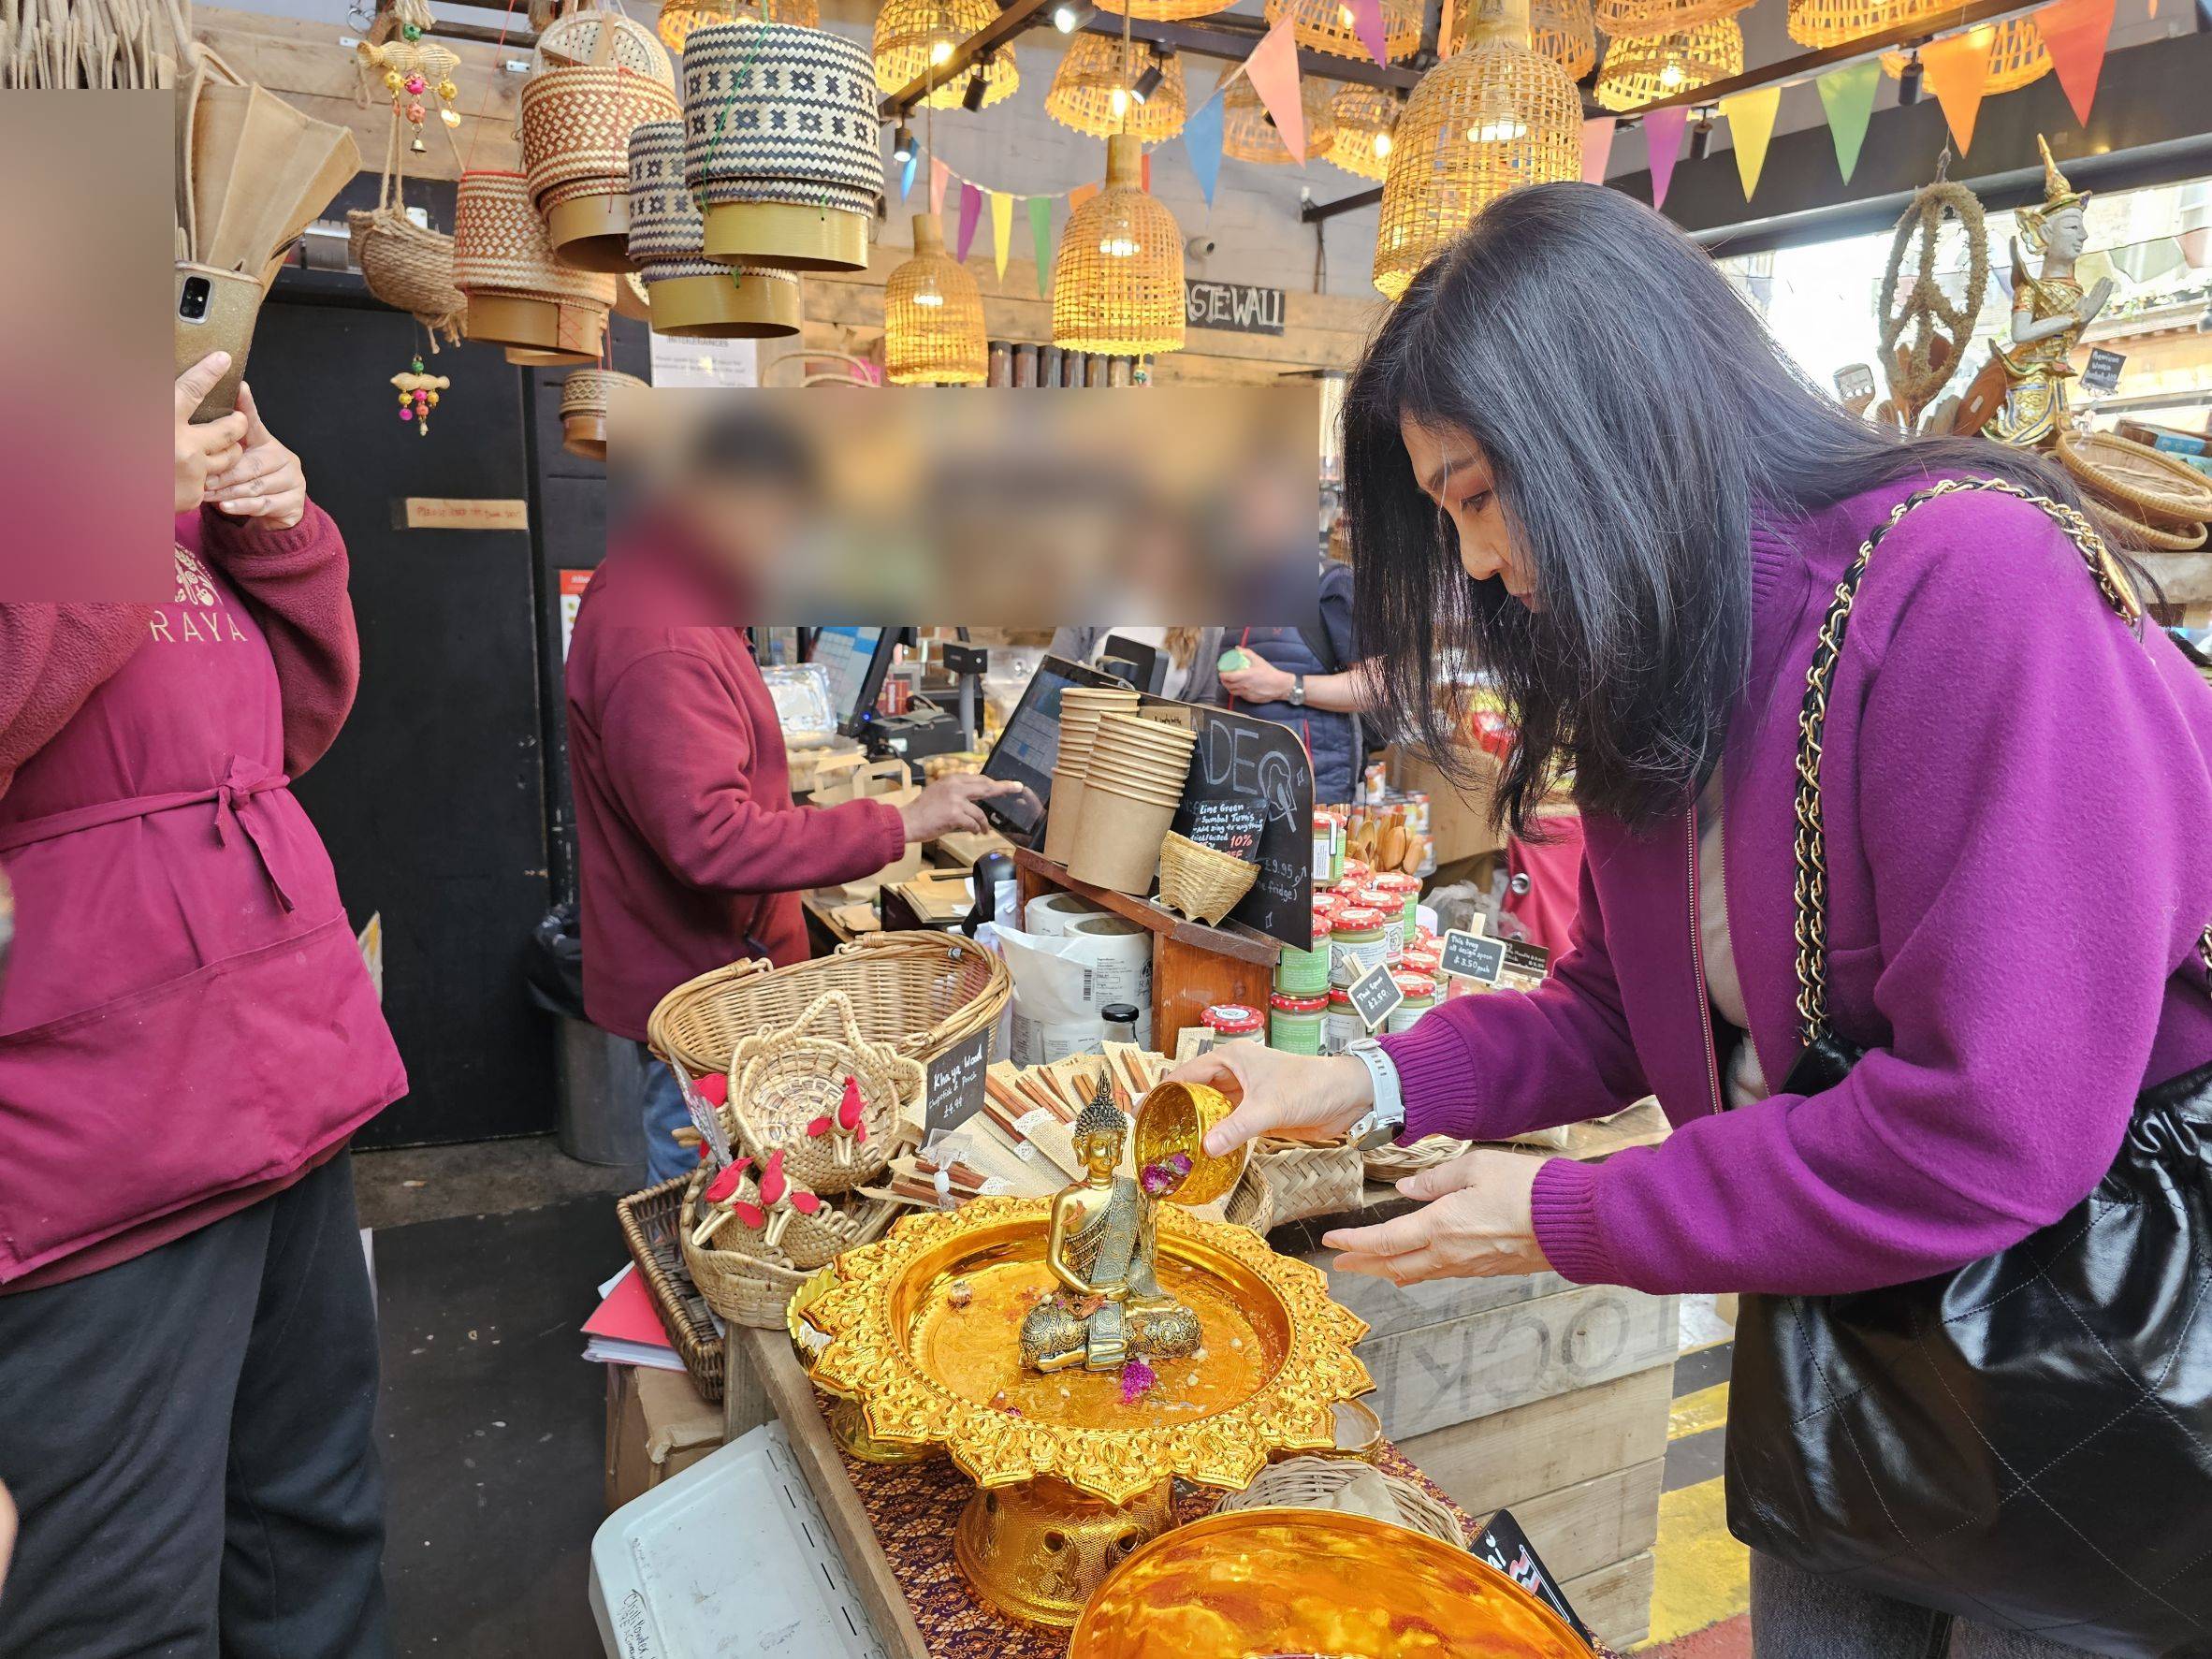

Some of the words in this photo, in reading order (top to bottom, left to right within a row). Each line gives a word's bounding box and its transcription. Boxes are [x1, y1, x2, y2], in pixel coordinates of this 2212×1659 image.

[150, 610, 248, 643] RAYA
[1200, 805, 1218, 815] Lime
[1219, 803, 1244, 813] Green
[1230, 834, 1253, 849] 10%
[1451, 936, 1464, 946] This
